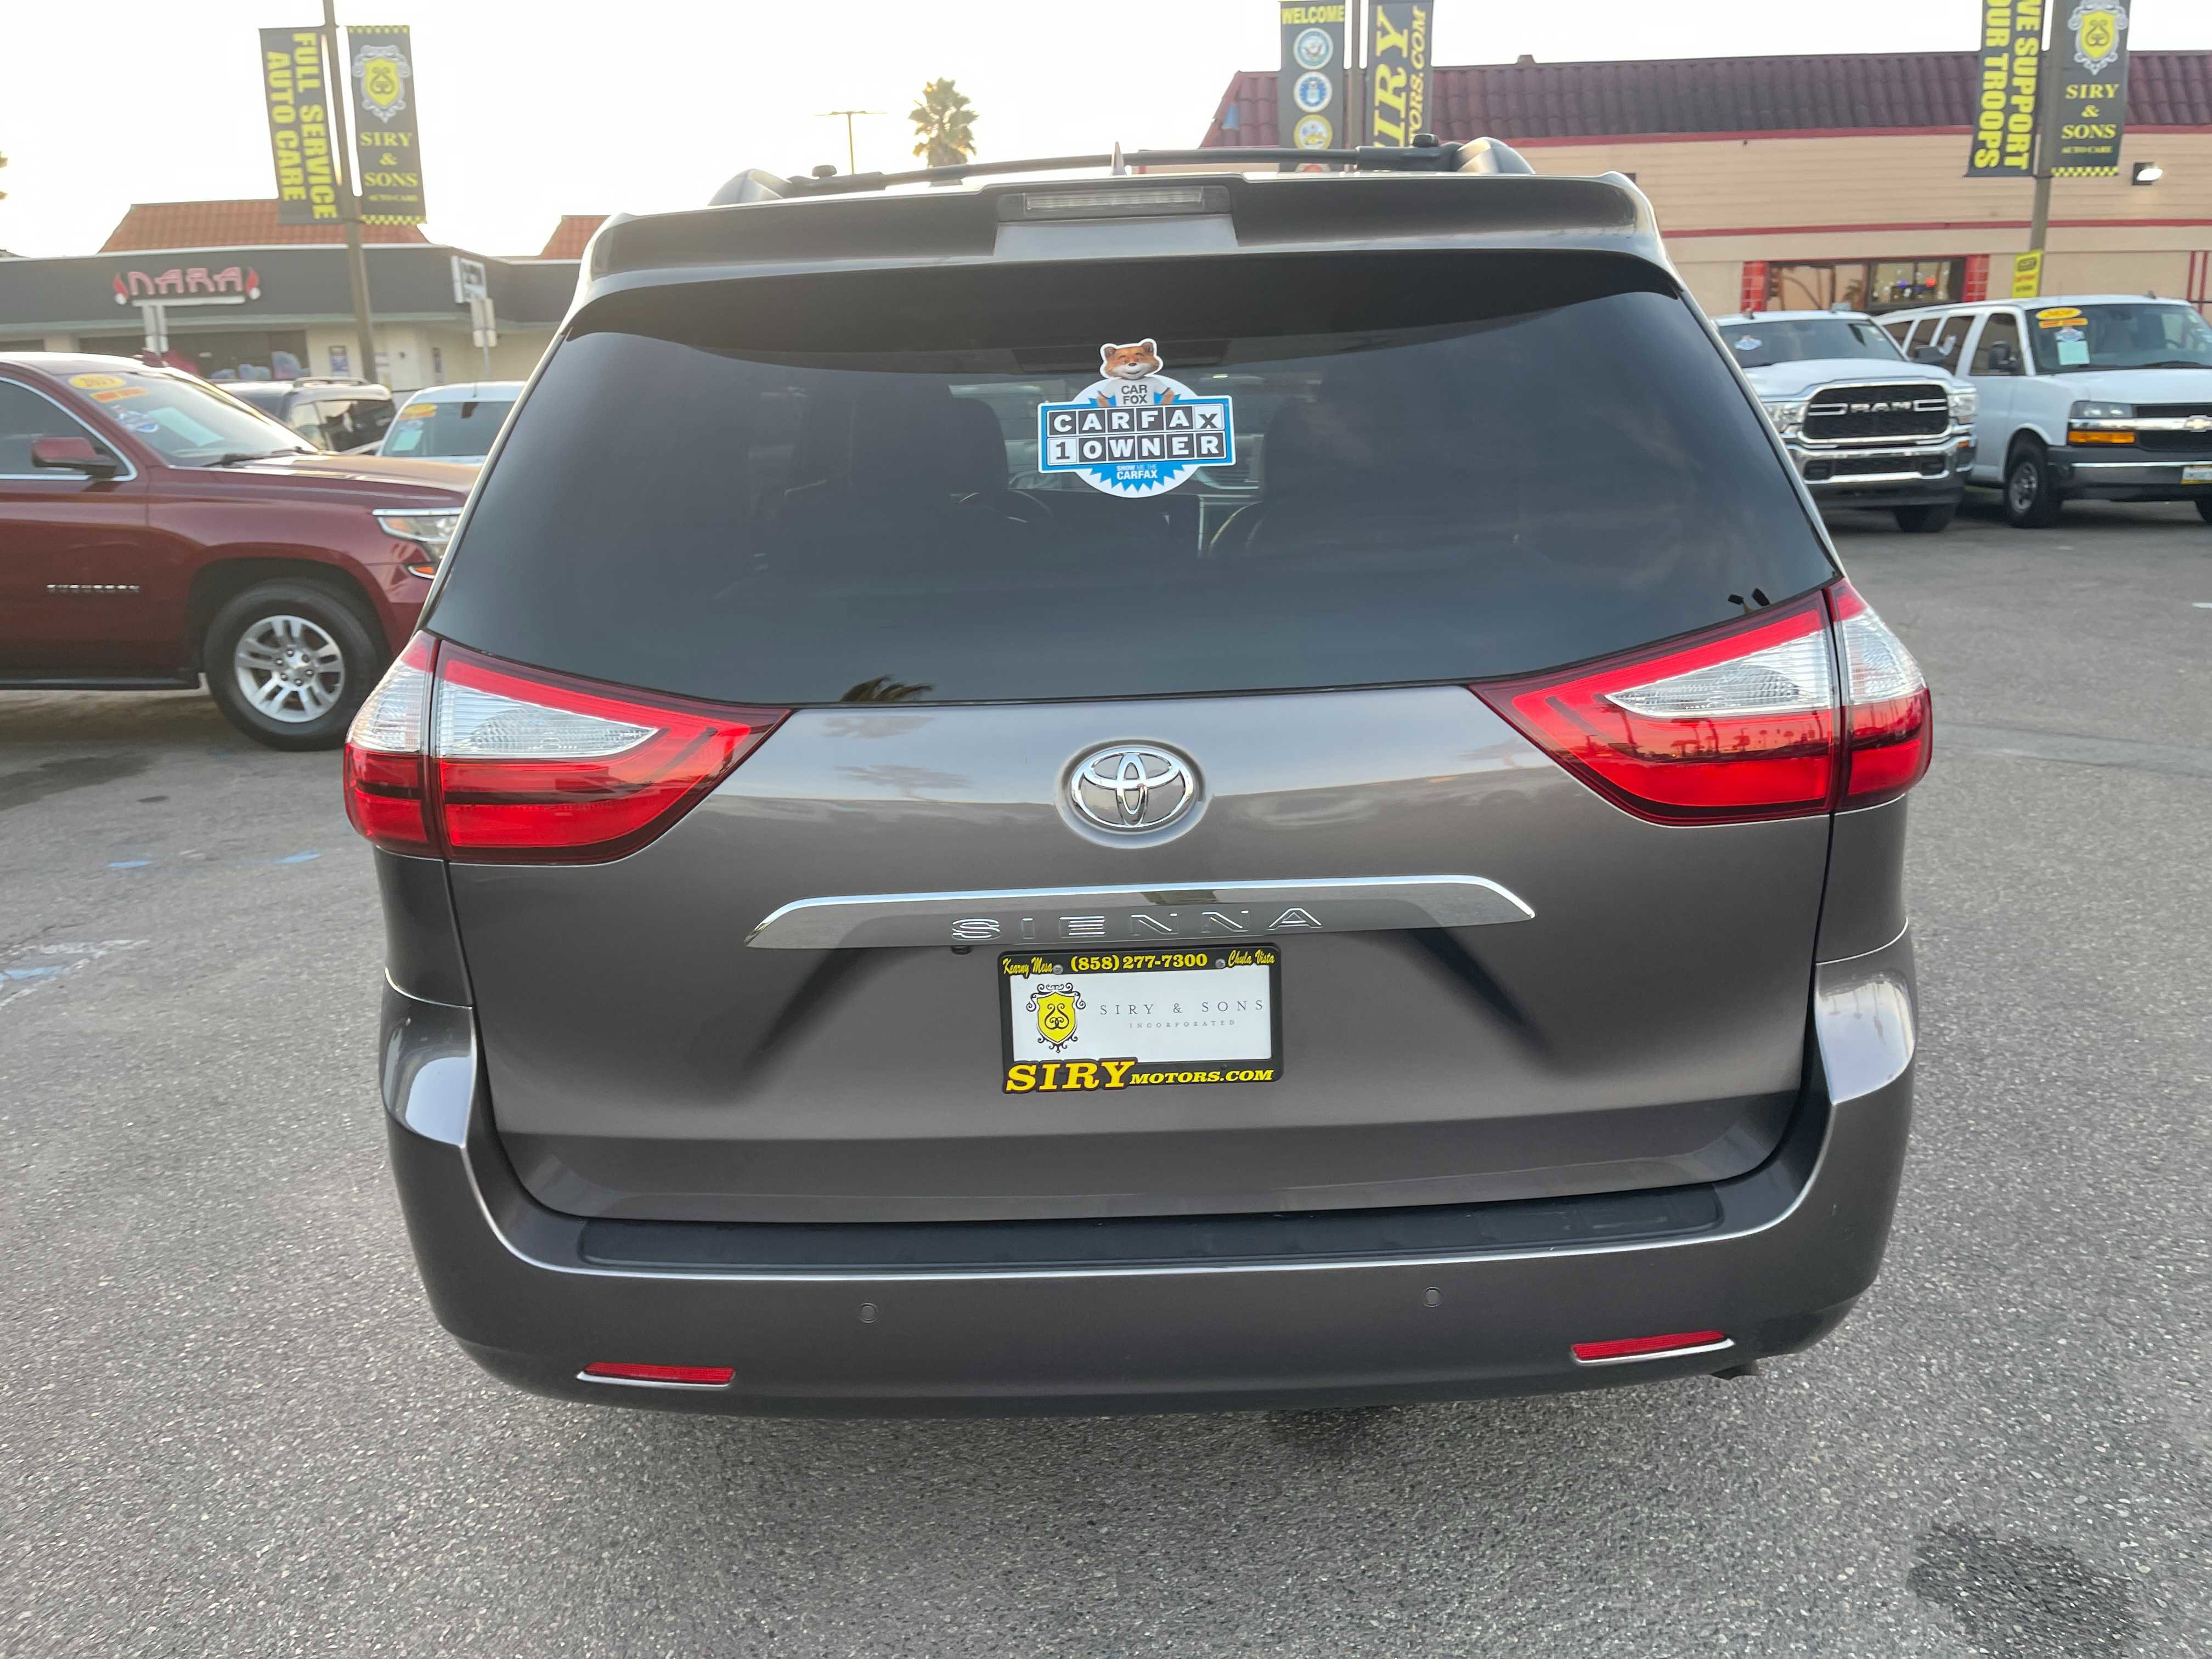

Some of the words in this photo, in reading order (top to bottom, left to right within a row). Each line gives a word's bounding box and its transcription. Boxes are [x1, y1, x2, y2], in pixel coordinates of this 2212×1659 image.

[1281, 5, 1344, 25] WELCOME
[292, 33, 320, 93] FULL
[1373, 5, 1408, 147] IRY
[266, 52, 296, 123] AUTO
[2065, 84, 2119, 99] SIRY
[1974, 52, 2009, 168] TROOPS
[2004, 37, 2039, 170] SUPPORT
[2081, 105, 2100, 118] &
[359, 132, 413, 147] SIRY
[2061, 124, 2117, 139] SONS
[275, 130, 307, 201] CARE
[300, 105, 337, 219] SERVICE
[380, 153, 397, 165] &
[364, 172, 418, 188] SONS
[127, 267, 244, 295] NARA
[1121, 385, 1147, 394] CAR
[1123, 394, 1147, 404] FOX
[1053, 410, 1217, 432] CARFAX
[1116, 470, 1158, 480] CARFAX
[950, 908, 1322, 940] SIENNA
[1002, 958, 1030, 978] Kearny
[1031, 957, 1053, 973] Mesa
[1070, 955, 1119, 972] (858)
[1123, 953, 1207, 969] 277-7300
[1228, 950, 1252, 967] Chula
[1254, 949, 1275, 964] Vista
[1100, 1005, 1154, 1015] SIRY
[1173, 1003, 1183, 1013] &
[1202, 1000, 1262, 1013] SONS
[1129, 1020, 1235, 1028] INCORPORATED
